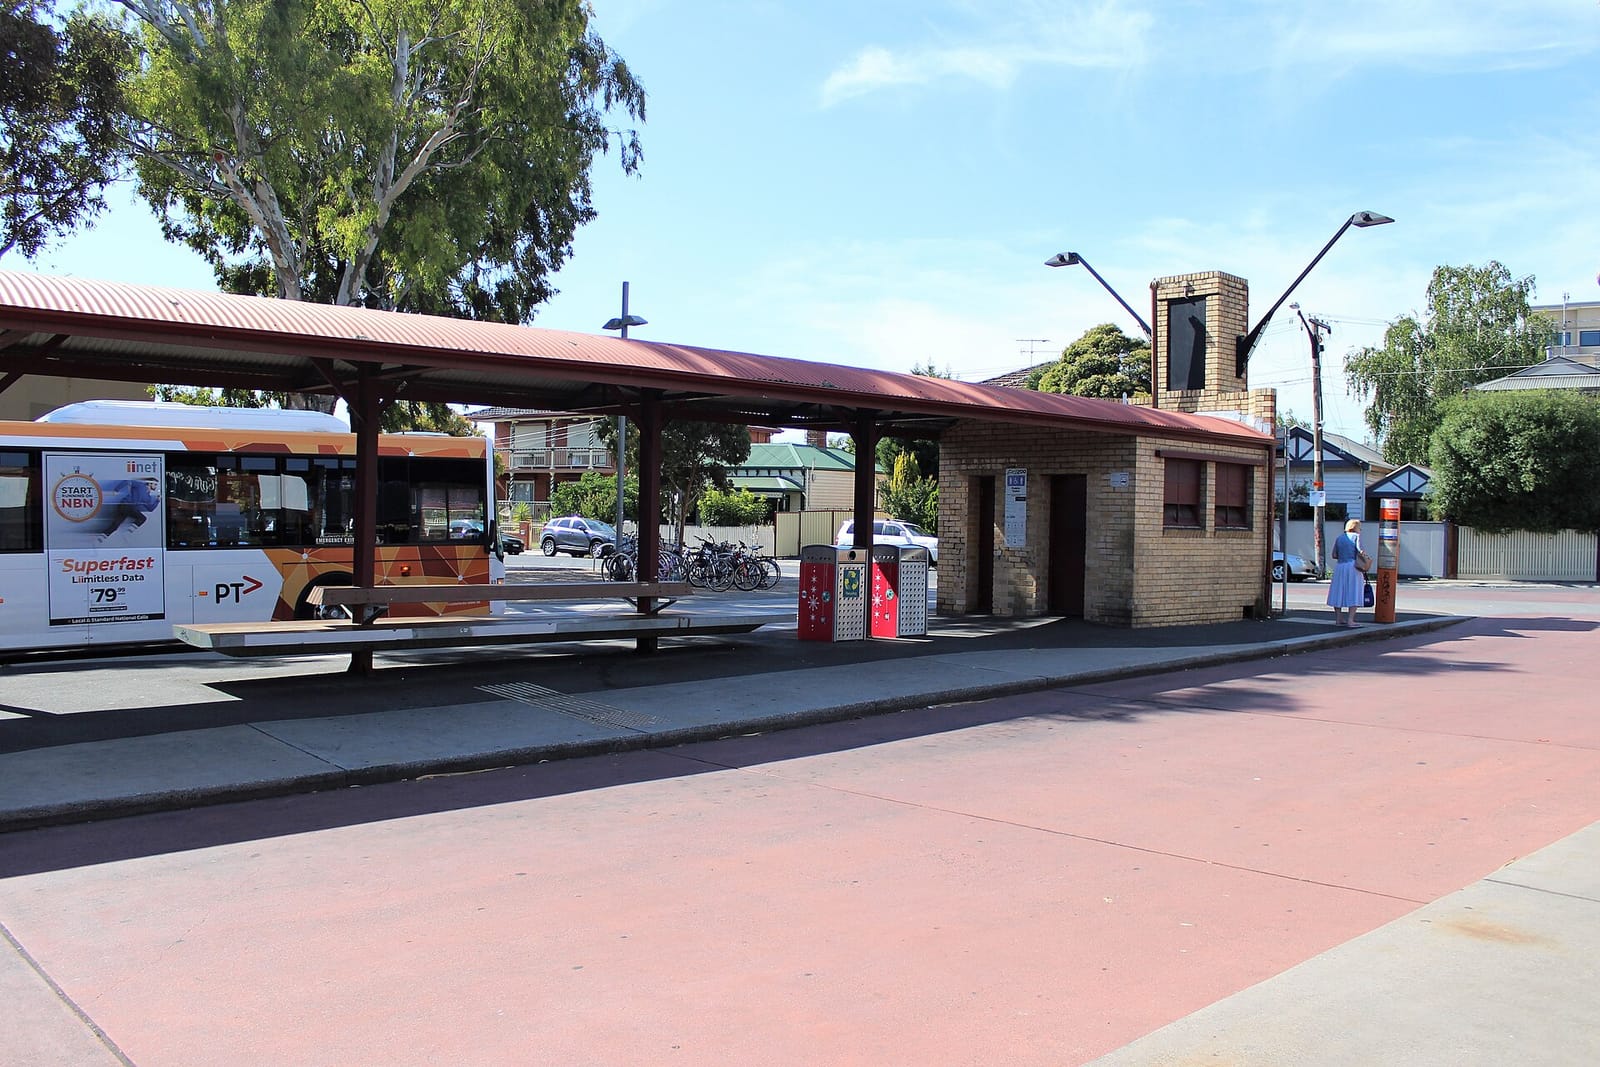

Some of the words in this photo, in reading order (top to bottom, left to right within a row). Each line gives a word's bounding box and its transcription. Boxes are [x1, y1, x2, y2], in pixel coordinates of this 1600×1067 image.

[127, 461, 157, 473] iinet
[61, 486, 92, 494] START
[62, 498, 94, 508] NBN
[62, 556, 155, 575] Superfast
[121, 574, 145, 582] Data
